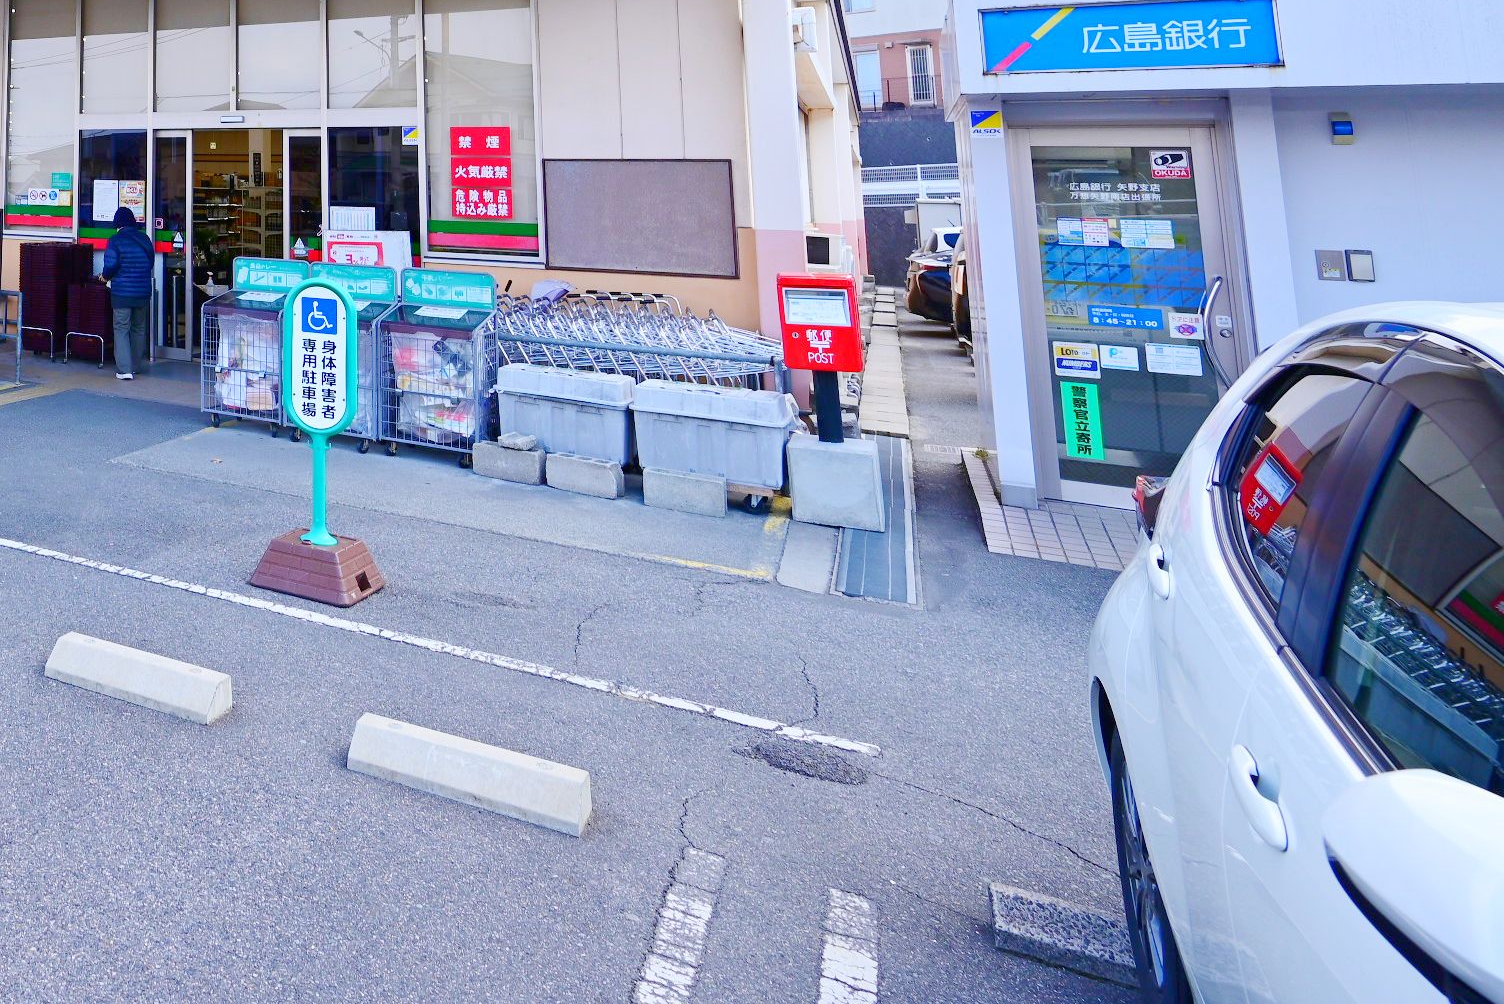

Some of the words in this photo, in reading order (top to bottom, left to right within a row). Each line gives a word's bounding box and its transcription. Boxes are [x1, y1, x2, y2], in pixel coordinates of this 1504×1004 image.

[1082, 18, 1252, 54] 広島銀行
[458, 136, 499, 148] 禁煙
[455, 165, 508, 179] 火気厳禁
[1069, 182, 1111, 192] 広島銀行
[1117, 182, 1161, 192] 矢野支店
[455, 189, 508, 203] 危険物品
[455, 202, 509, 216] 持込み厳禁
[805, 329, 832, 343] 郵便
[808, 352, 833, 364] POST
[301, 338, 317, 418] 専用駐車場
[321, 339, 337, 420] 身体障害者
[1071, 385, 1093, 456] 警察官立寄所
